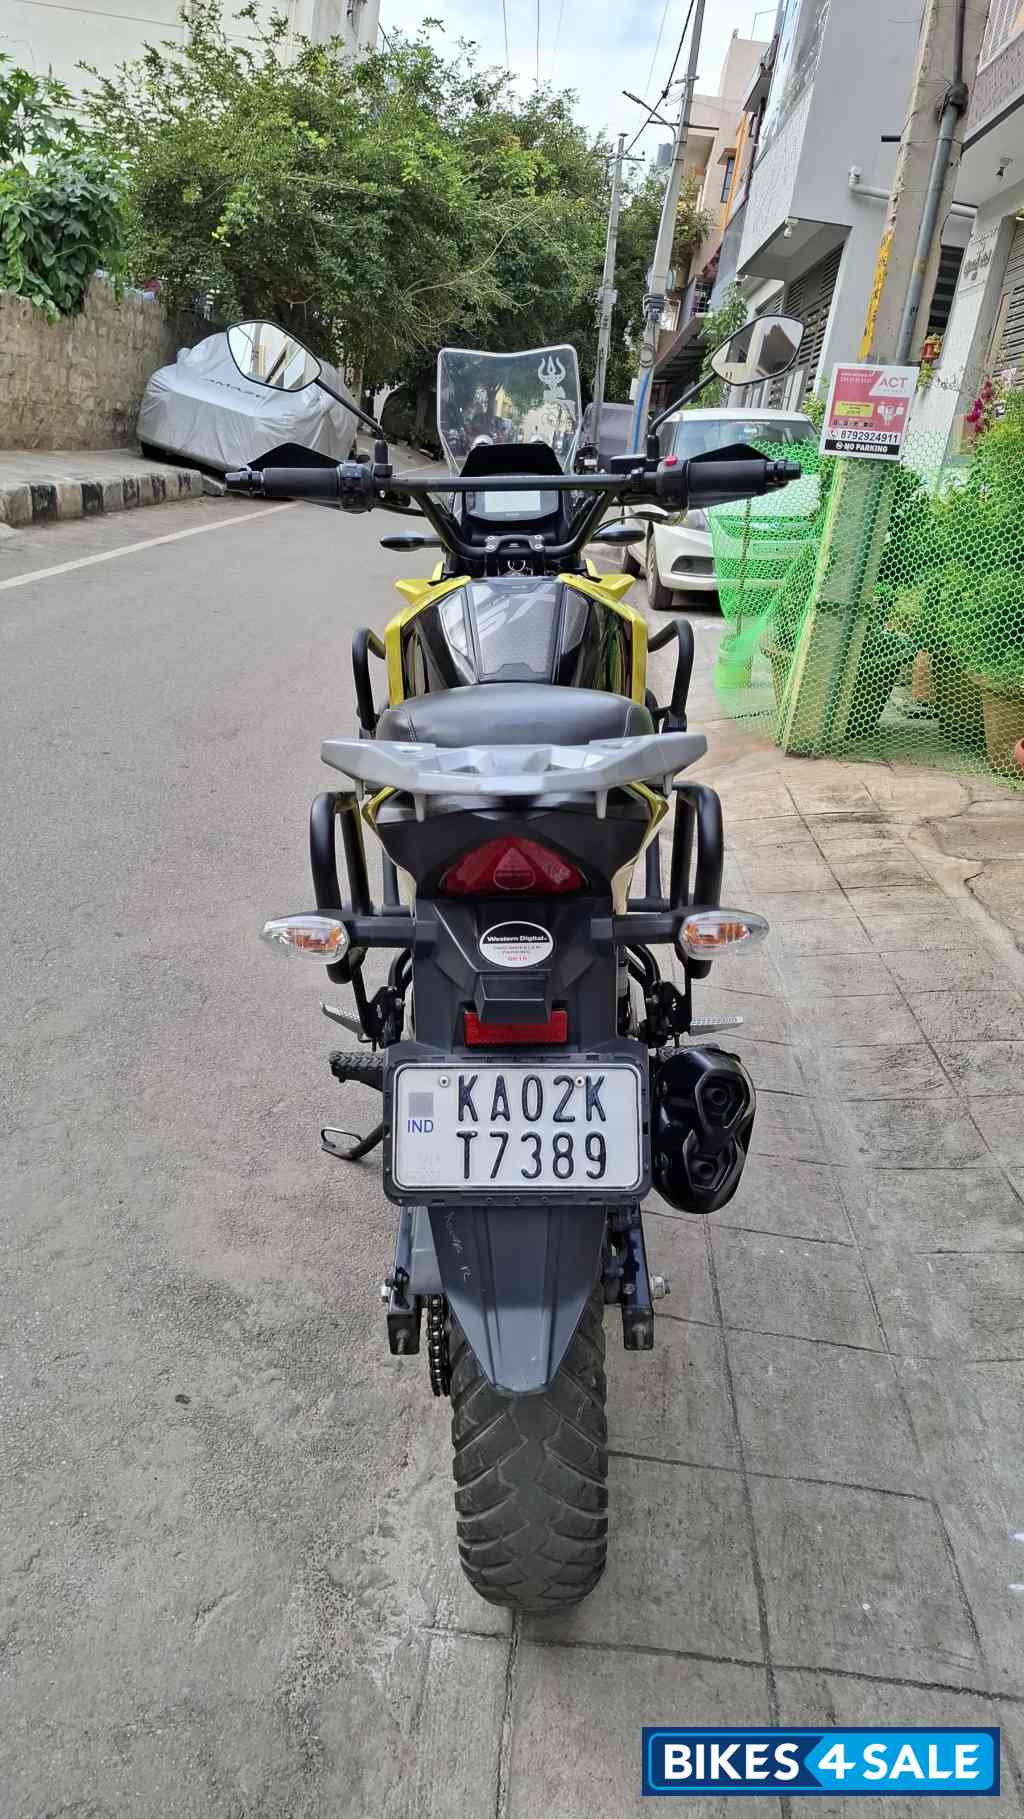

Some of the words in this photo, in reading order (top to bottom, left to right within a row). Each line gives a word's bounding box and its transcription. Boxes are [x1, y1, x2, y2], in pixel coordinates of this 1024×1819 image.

[879, 376, 909, 388] ACT
[840, 430, 898, 443] 8792924911
[844, 441, 855, 449] NO
[855, 443, 888, 453] PARKING
[457, 1074, 607, 1122] KA02K
[408, 1119, 434, 1133] IND
[456, 1131, 607, 1180] T7389
